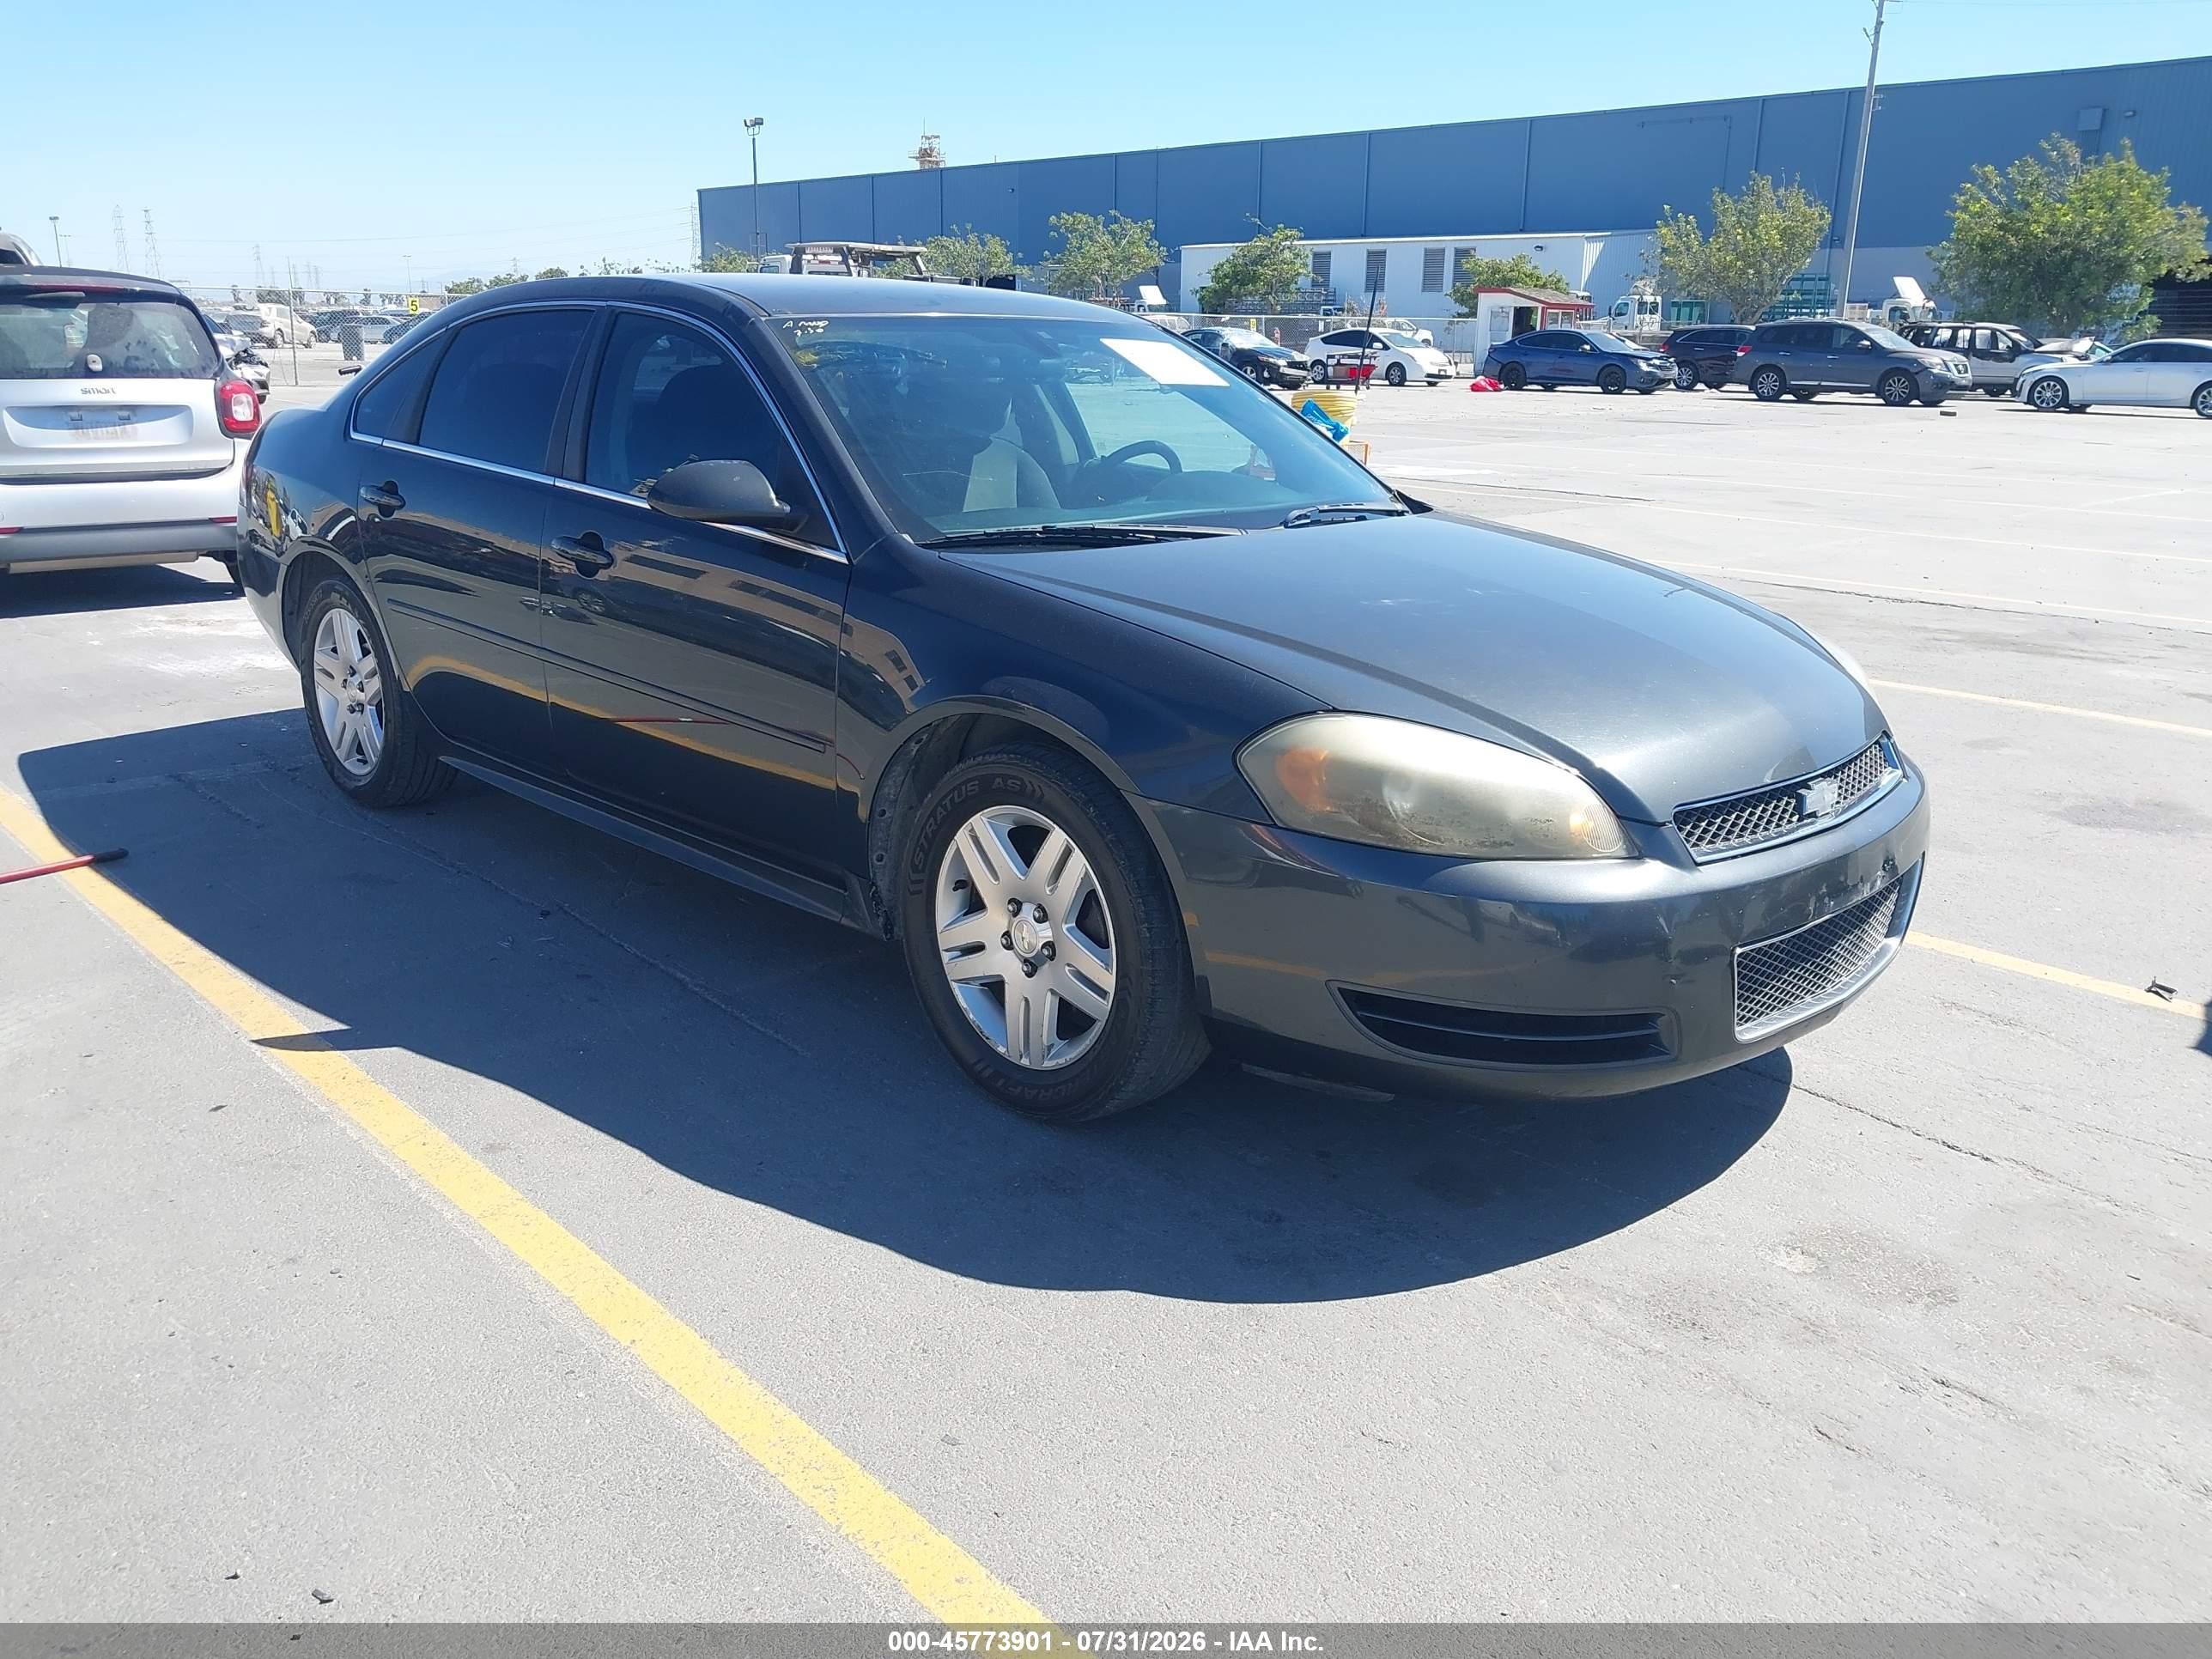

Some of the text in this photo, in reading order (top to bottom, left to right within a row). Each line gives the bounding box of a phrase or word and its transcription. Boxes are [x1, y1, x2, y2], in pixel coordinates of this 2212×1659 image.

[410, 301, 418, 312] 5
[914, 777, 1021, 870] STRATUS AS
